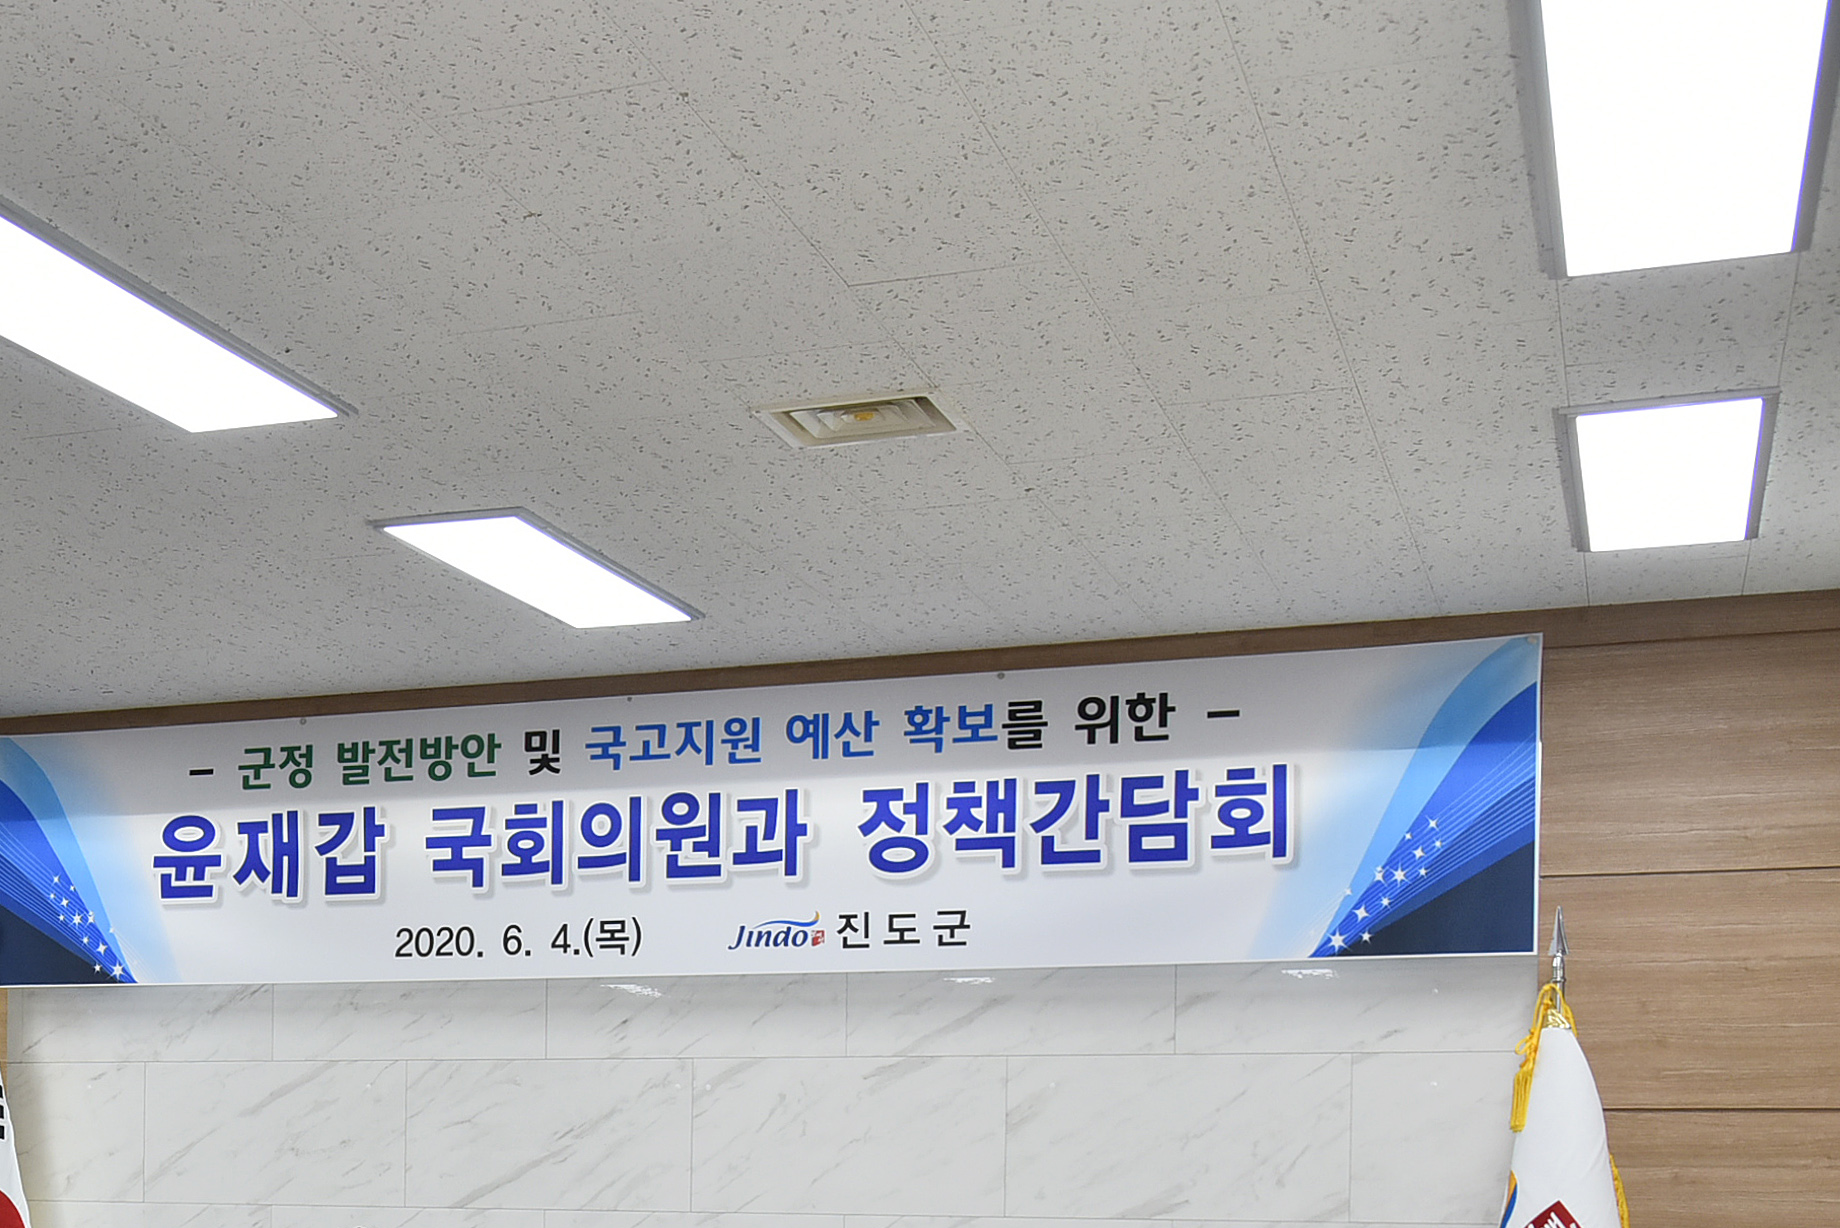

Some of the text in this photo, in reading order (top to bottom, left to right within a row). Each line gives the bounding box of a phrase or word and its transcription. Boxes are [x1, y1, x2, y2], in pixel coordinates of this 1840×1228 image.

[238, 743, 314, 789] 군정
[336, 731, 502, 785] 발전방안
[523, 728, 561, 775] 및
[585, 716, 762, 770] 국고지원
[786, 709, 880, 759] 예산
[903, 699, 1048, 753] 확보를
[1074, 692, 1176, 745] 위한
[153, 763, 1288, 899] 윤재갑 국회의원과 정책간담회
[394, 916, 643, 958] 2020. 6. 4.(목)
[727, 919, 809, 951] Jindo
